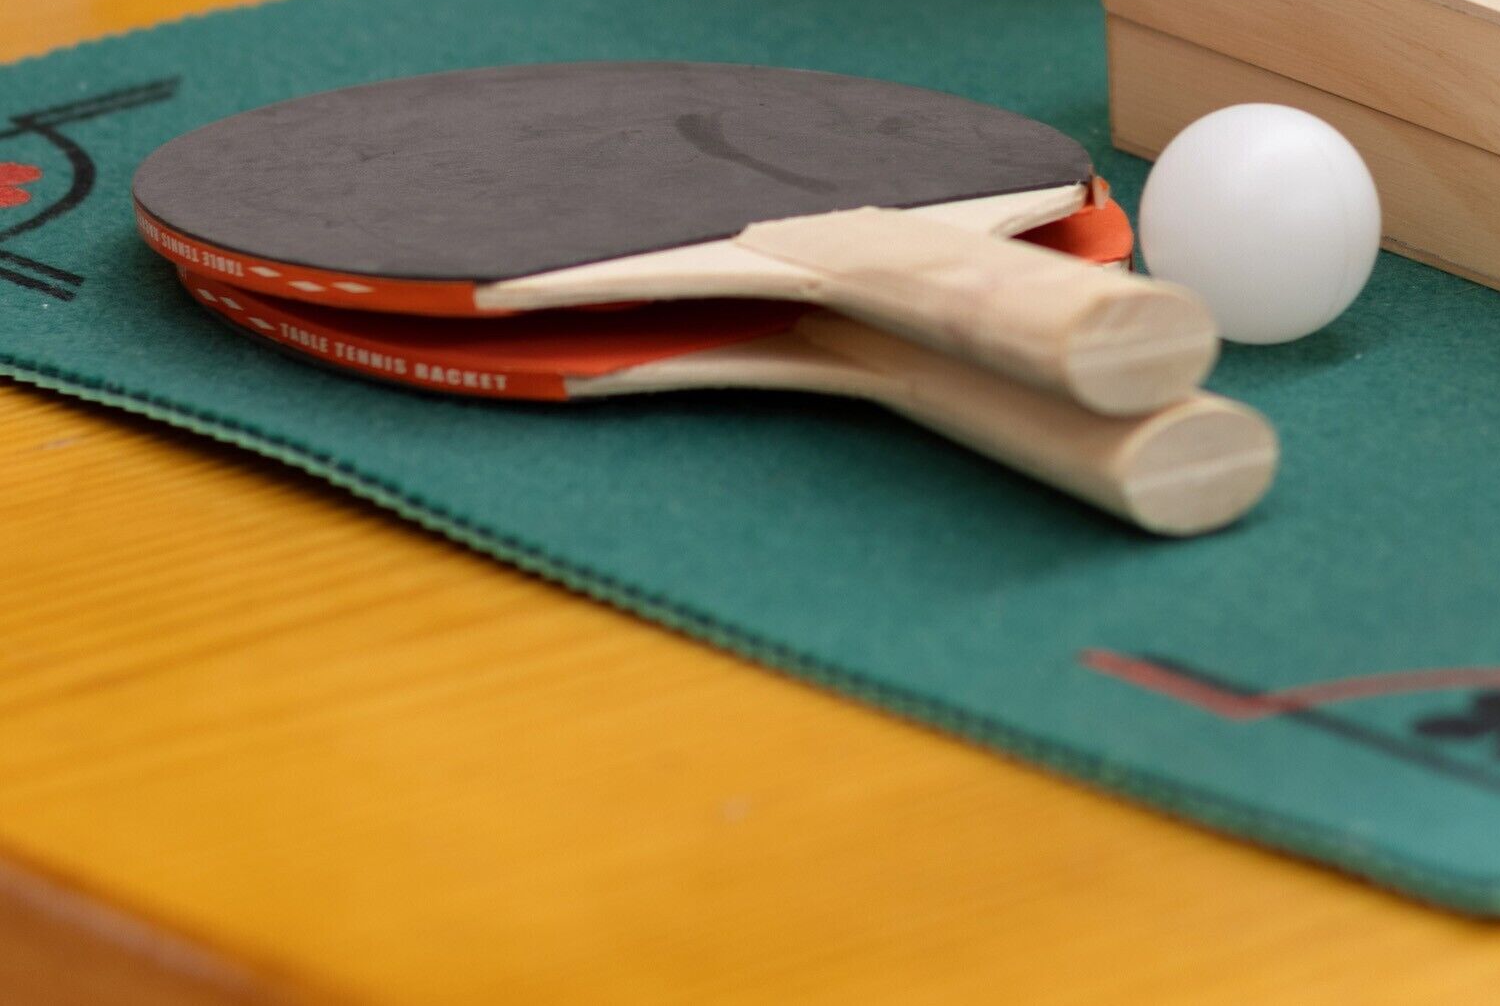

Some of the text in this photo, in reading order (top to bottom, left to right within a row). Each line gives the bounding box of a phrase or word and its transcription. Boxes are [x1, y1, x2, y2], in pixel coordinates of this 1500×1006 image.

[161, 232, 200, 263] TENNIS
[201, 251, 245, 277] TABLE
[279, 322, 508, 391] TABLE TENNIS RACKET
